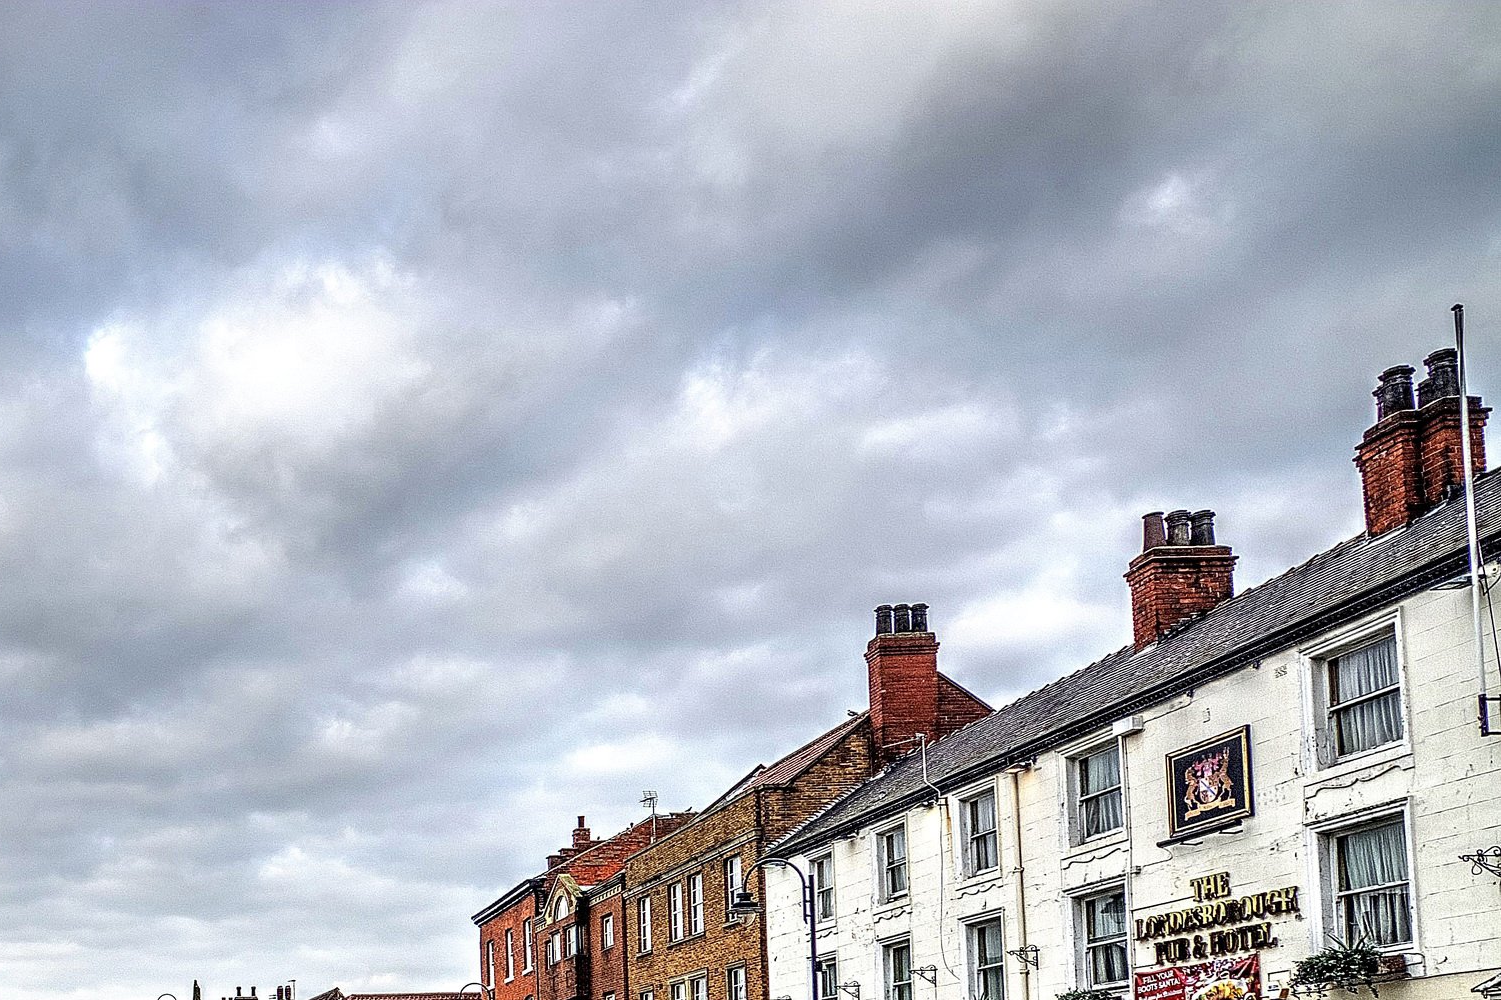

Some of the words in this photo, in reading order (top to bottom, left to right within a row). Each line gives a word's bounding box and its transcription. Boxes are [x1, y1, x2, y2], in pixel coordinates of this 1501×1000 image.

[1190, 871, 1231, 903] THE
[1134, 885, 1300, 941] LONDESBOROUGH
[1154, 937, 1191, 966] PUB
[1193, 934, 1209, 959] &
[1209, 922, 1278, 957] HOTEL
[1137, 983, 1158, 994] BOOTS
[1158, 977, 1181, 989] SANTA!
[1142, 975, 1156, 985] FILL
[1156, 969, 1174, 981] YOUR
